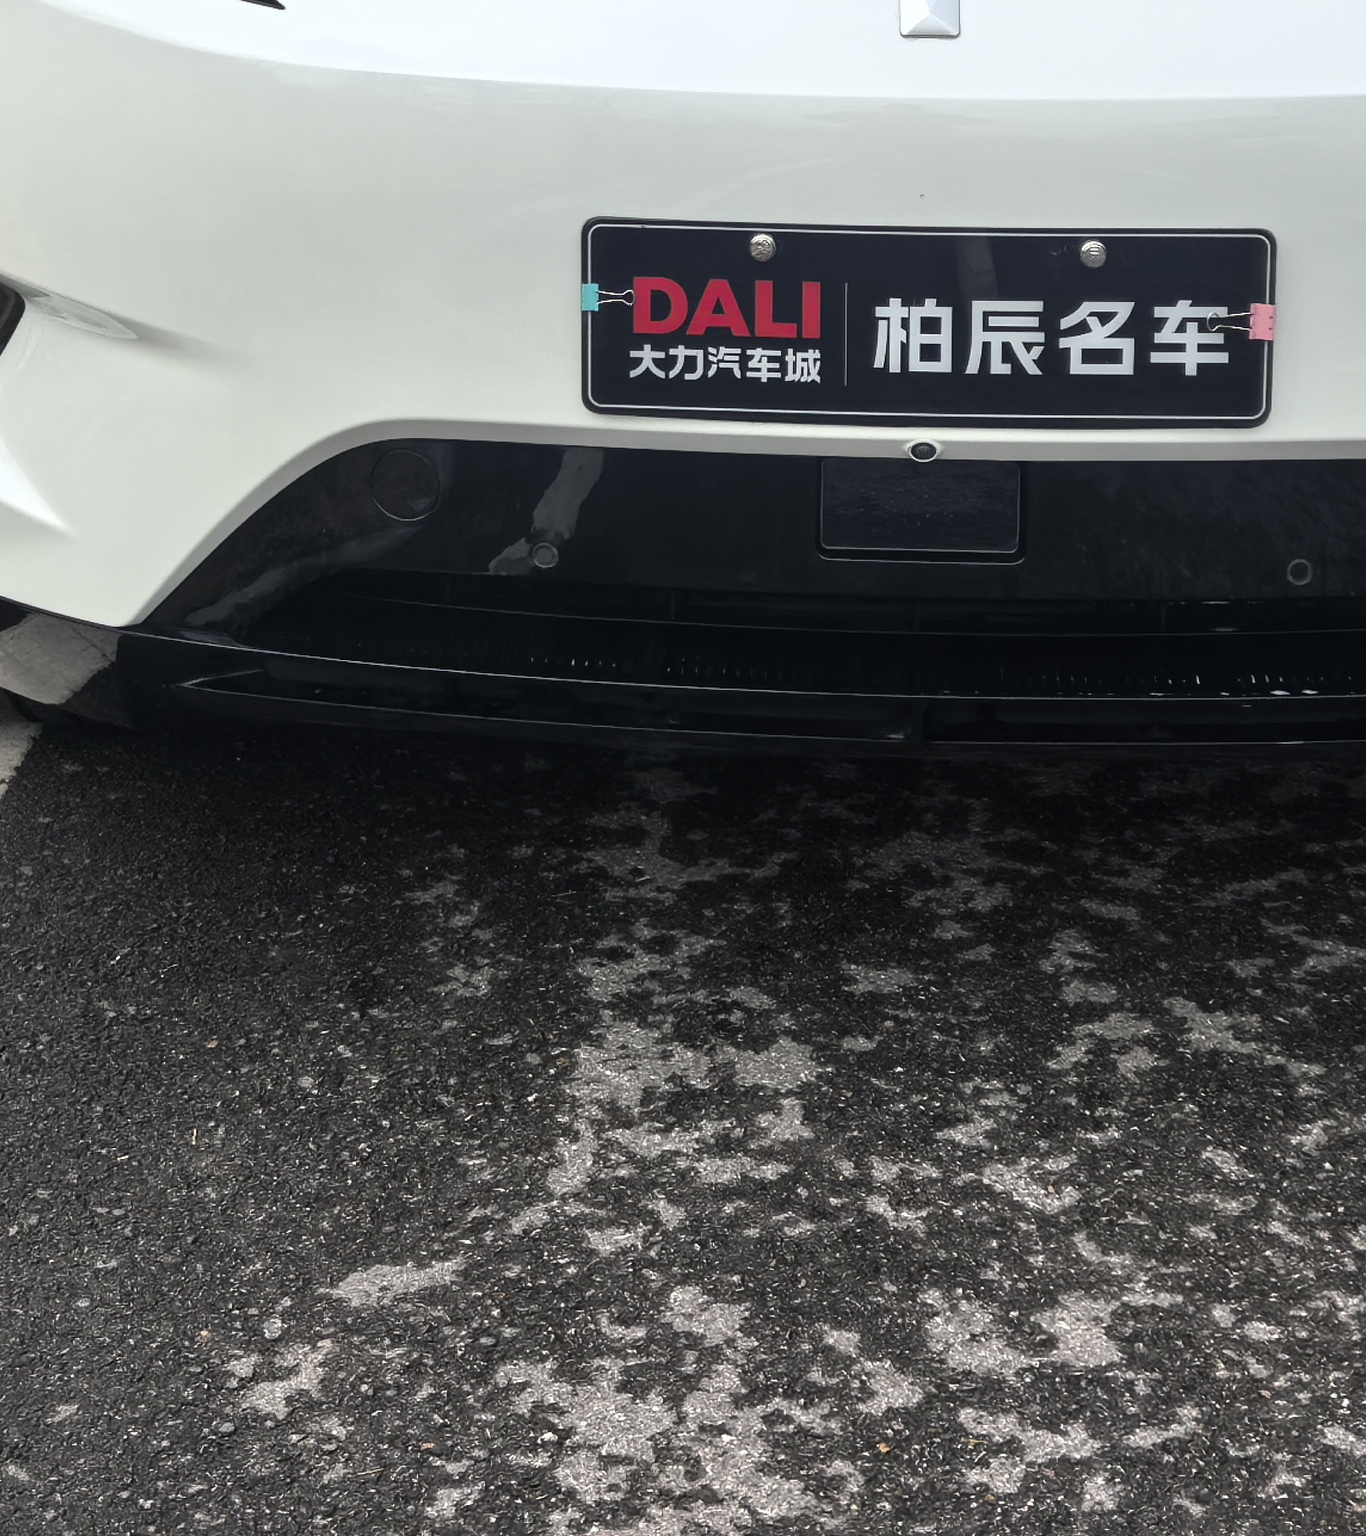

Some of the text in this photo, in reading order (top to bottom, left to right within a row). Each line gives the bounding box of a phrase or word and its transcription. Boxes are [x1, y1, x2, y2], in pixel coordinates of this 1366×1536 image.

[632, 276, 822, 339] DALI
[873, 297, 1231, 376] 柏辰名车
[628, 344, 822, 383] 大力汽车城
